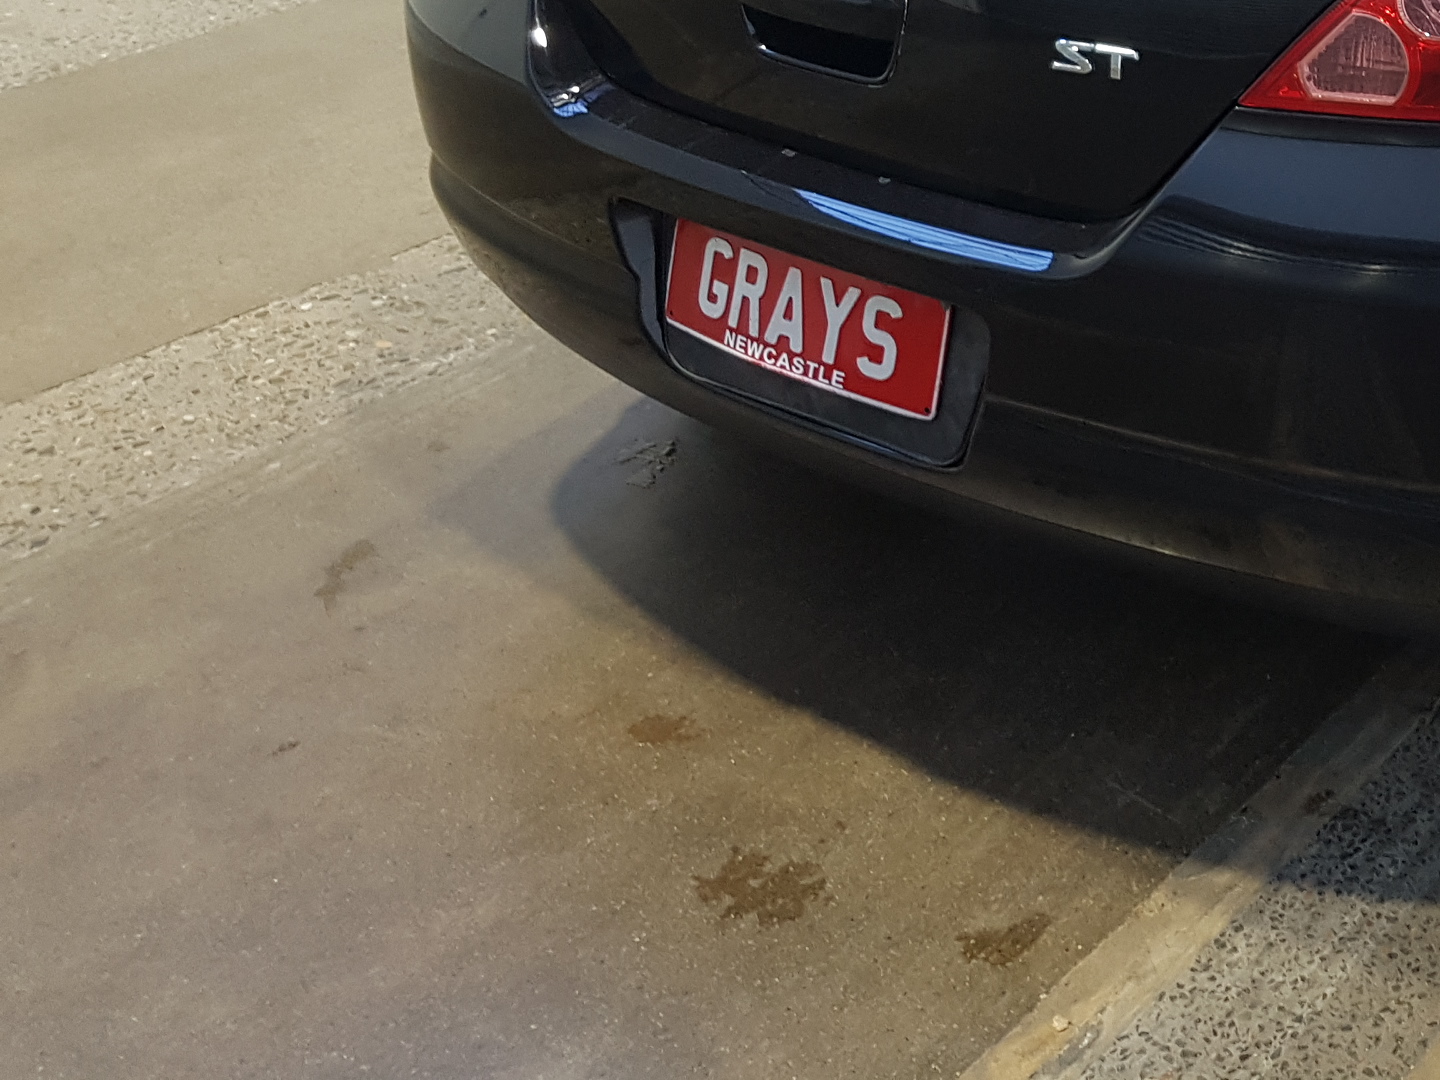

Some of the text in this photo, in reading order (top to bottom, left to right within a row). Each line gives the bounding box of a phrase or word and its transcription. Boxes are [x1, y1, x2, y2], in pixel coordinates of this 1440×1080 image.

[1051, 39, 1139, 80] ST
[698, 236, 904, 382] GRAYS
[723, 328, 846, 390] NEWCASTLE
